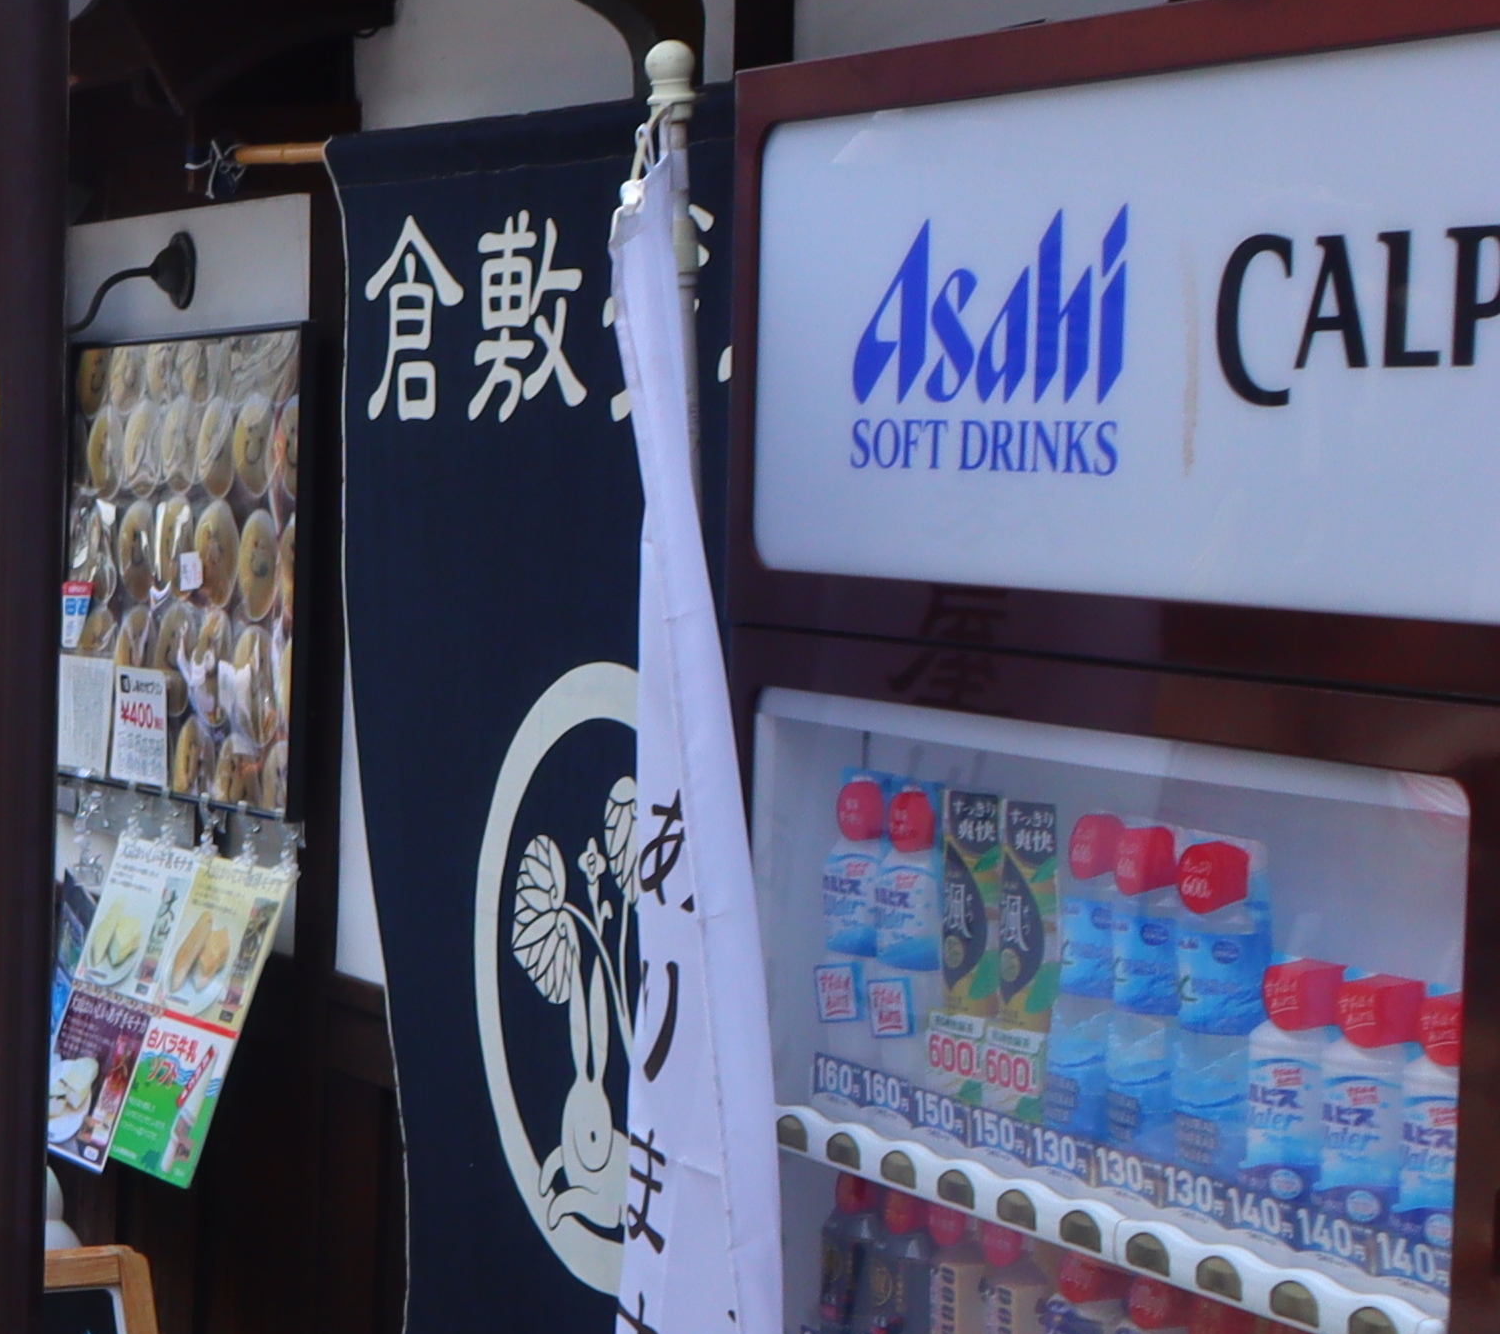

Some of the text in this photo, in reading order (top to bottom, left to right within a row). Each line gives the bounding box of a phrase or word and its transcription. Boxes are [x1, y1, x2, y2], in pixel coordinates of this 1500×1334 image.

[365, 210, 635, 424] 倉敷
[853, 203, 1130, 405] Asahi
[1215, 225, 1500, 408] CALP
[850, 420, 1118, 475] SOFT DRINKS
[958, 820, 998, 843] 爽快
[1014, 830, 1054, 853] 爽快
[146, 1028, 199, 1064] 白バラ牛乳
